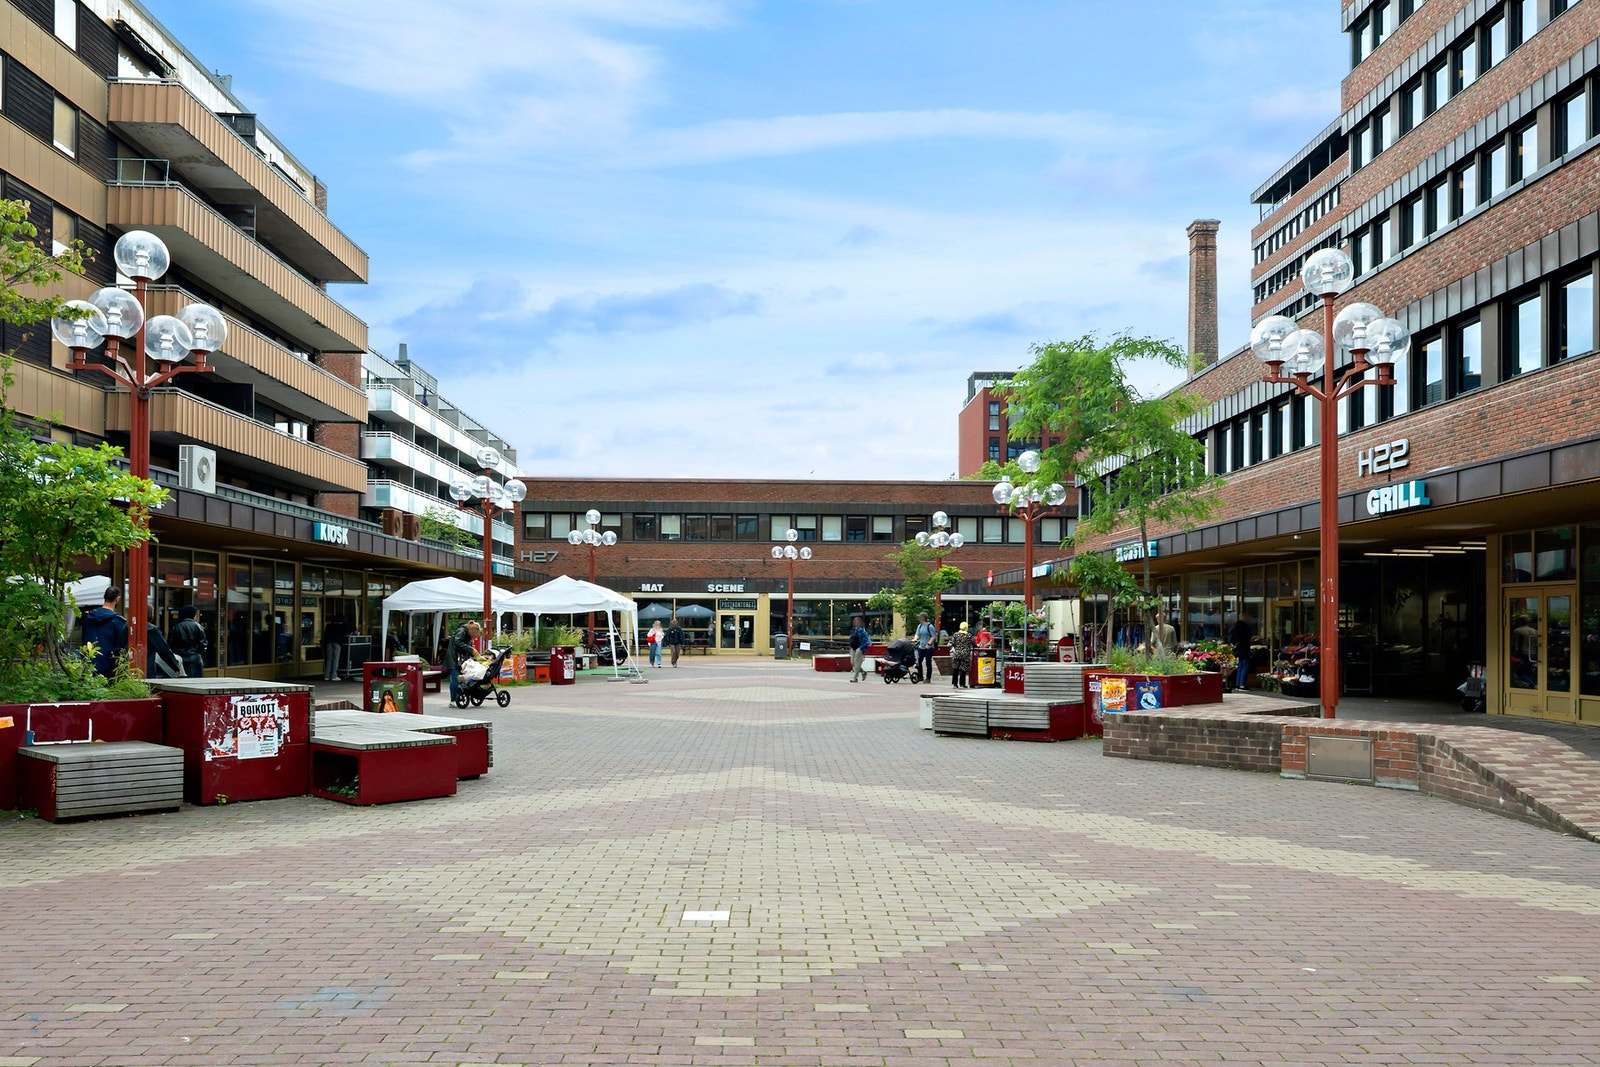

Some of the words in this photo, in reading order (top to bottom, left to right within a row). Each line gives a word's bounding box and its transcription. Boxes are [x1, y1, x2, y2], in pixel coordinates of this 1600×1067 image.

[1358, 438, 1410, 477] H22
[1366, 480, 1422, 515] GRILL
[320, 522, 349, 545] KIOSK
[520, 550, 559, 562] H27
[641, 583, 664, 592] MAT
[707, 584, 744, 592] SCENE
[240, 703, 276, 716] BOIKOTT
